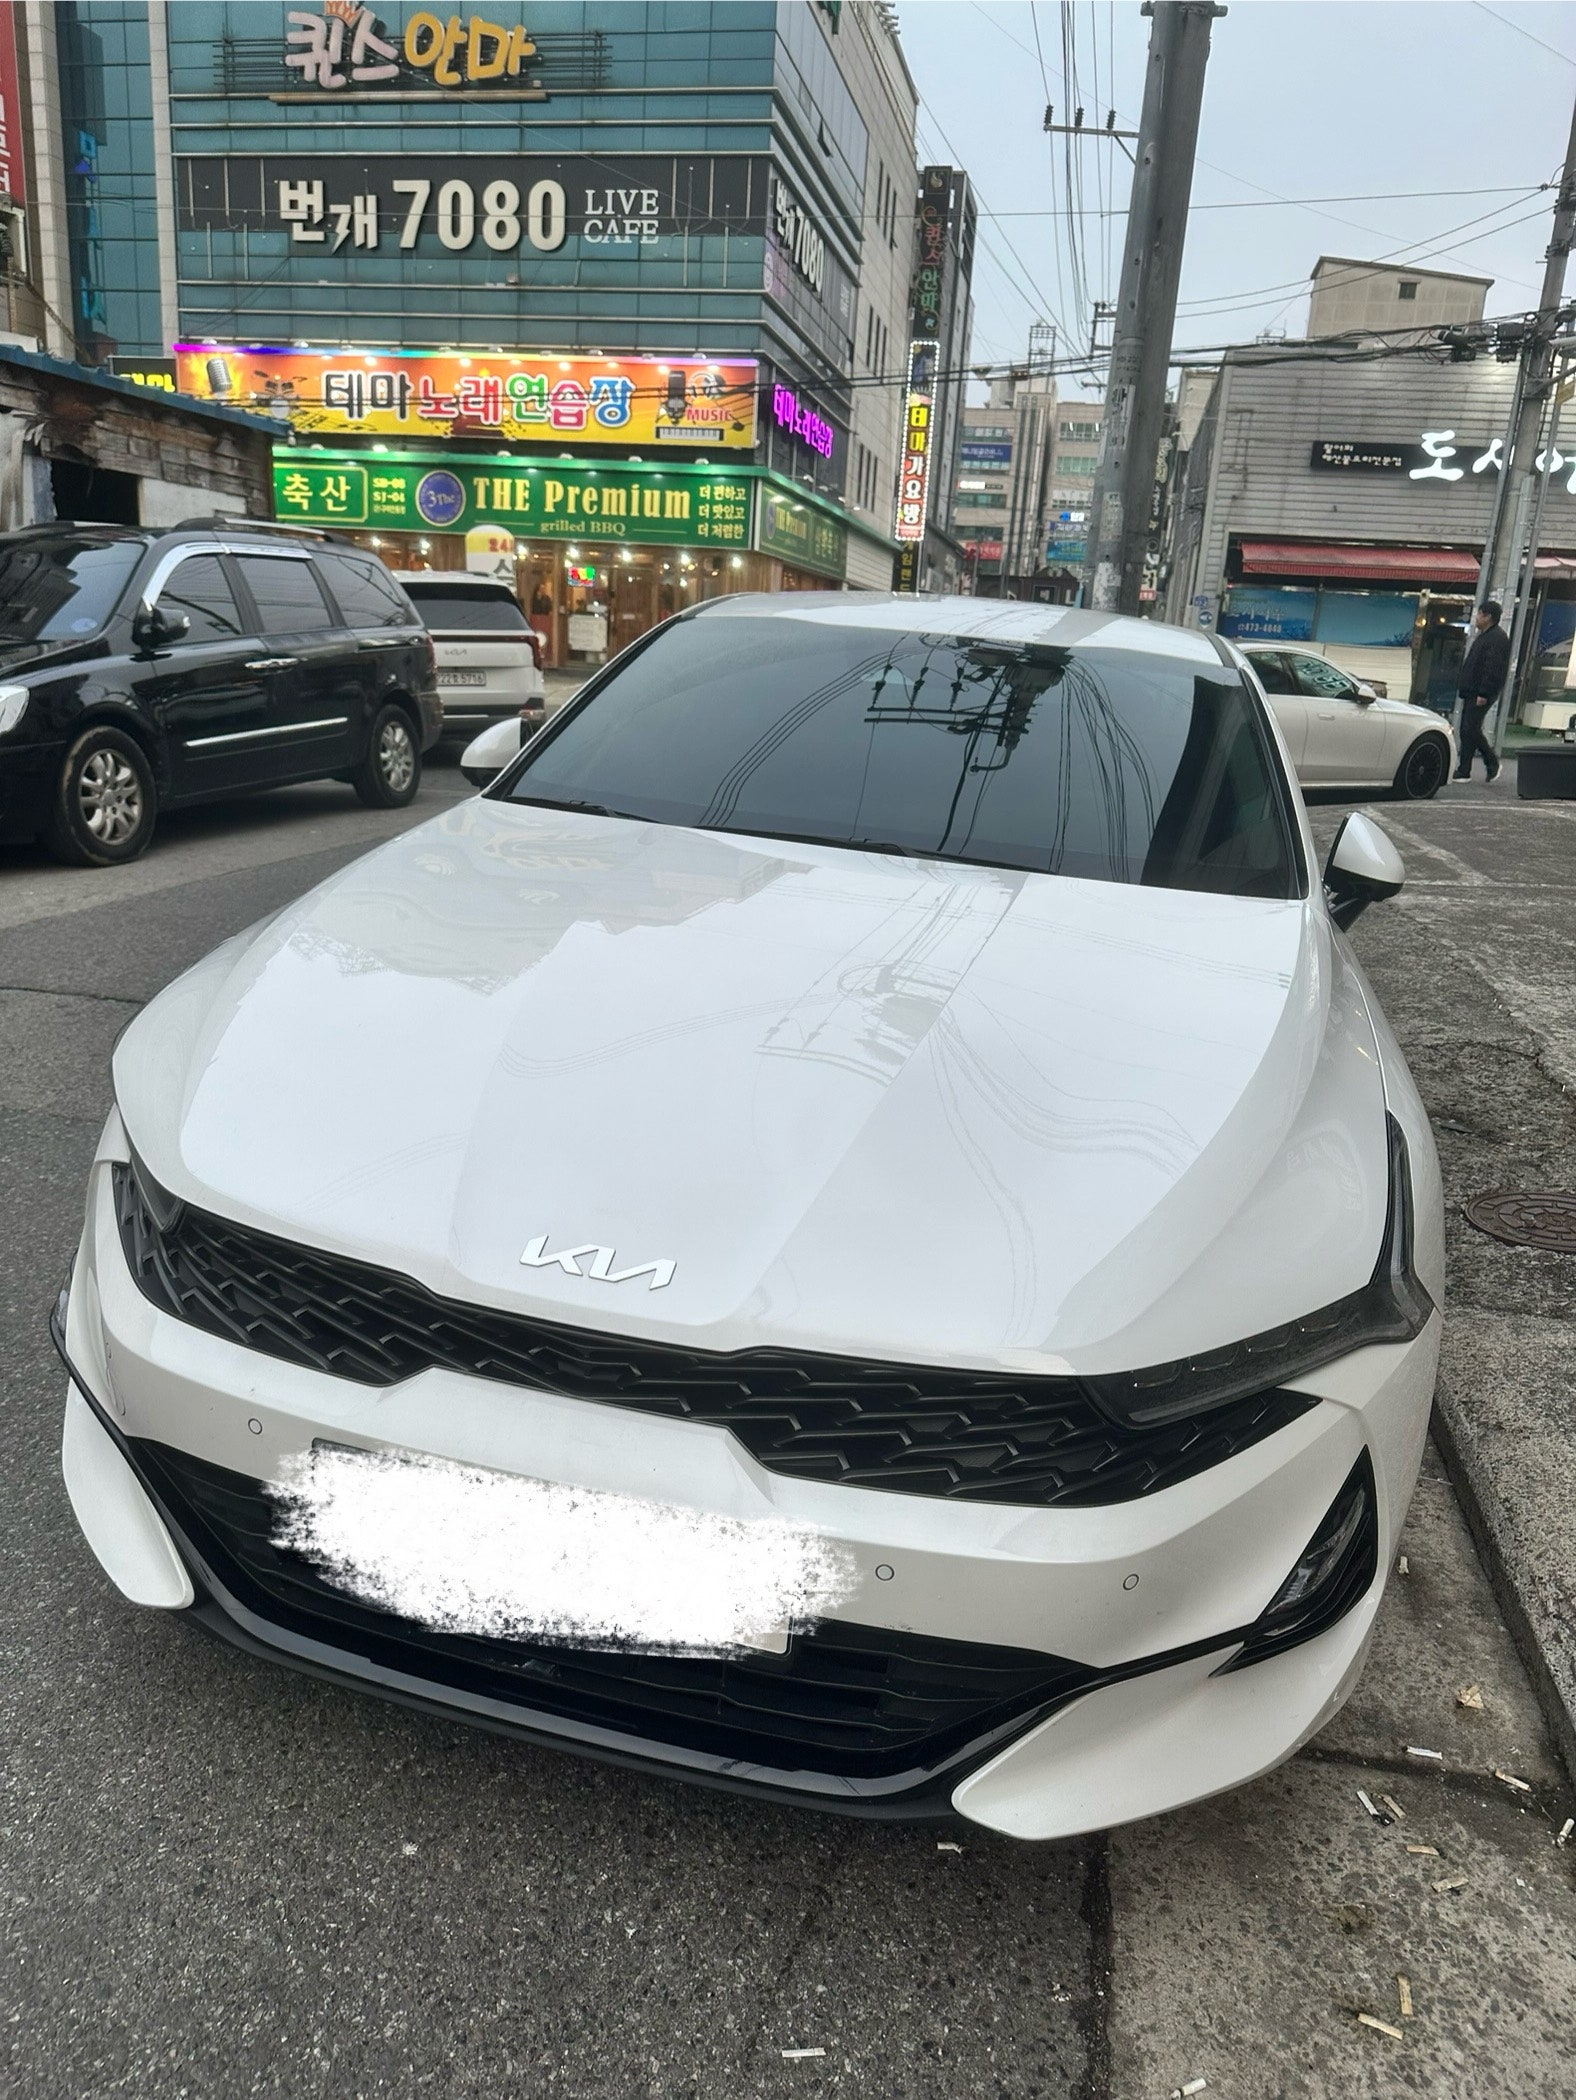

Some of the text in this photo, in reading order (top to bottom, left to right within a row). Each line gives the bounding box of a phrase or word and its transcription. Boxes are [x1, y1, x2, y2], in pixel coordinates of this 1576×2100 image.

[584, 189, 659, 215] LIVE
[393, 179, 567, 251] 7080
[584, 219, 660, 245] CAFE
[794, 205, 825, 293] 7080
[685, 407, 734, 422] MUSIC
[473, 477, 530, 511] THE
[544, 481, 690, 519] Premium
[699, 484, 711, 499] 더
[698, 504, 745, 519] 더 맛있고
[540, 521, 626, 537] grilled BBQ
[697, 523, 709, 538] 더
